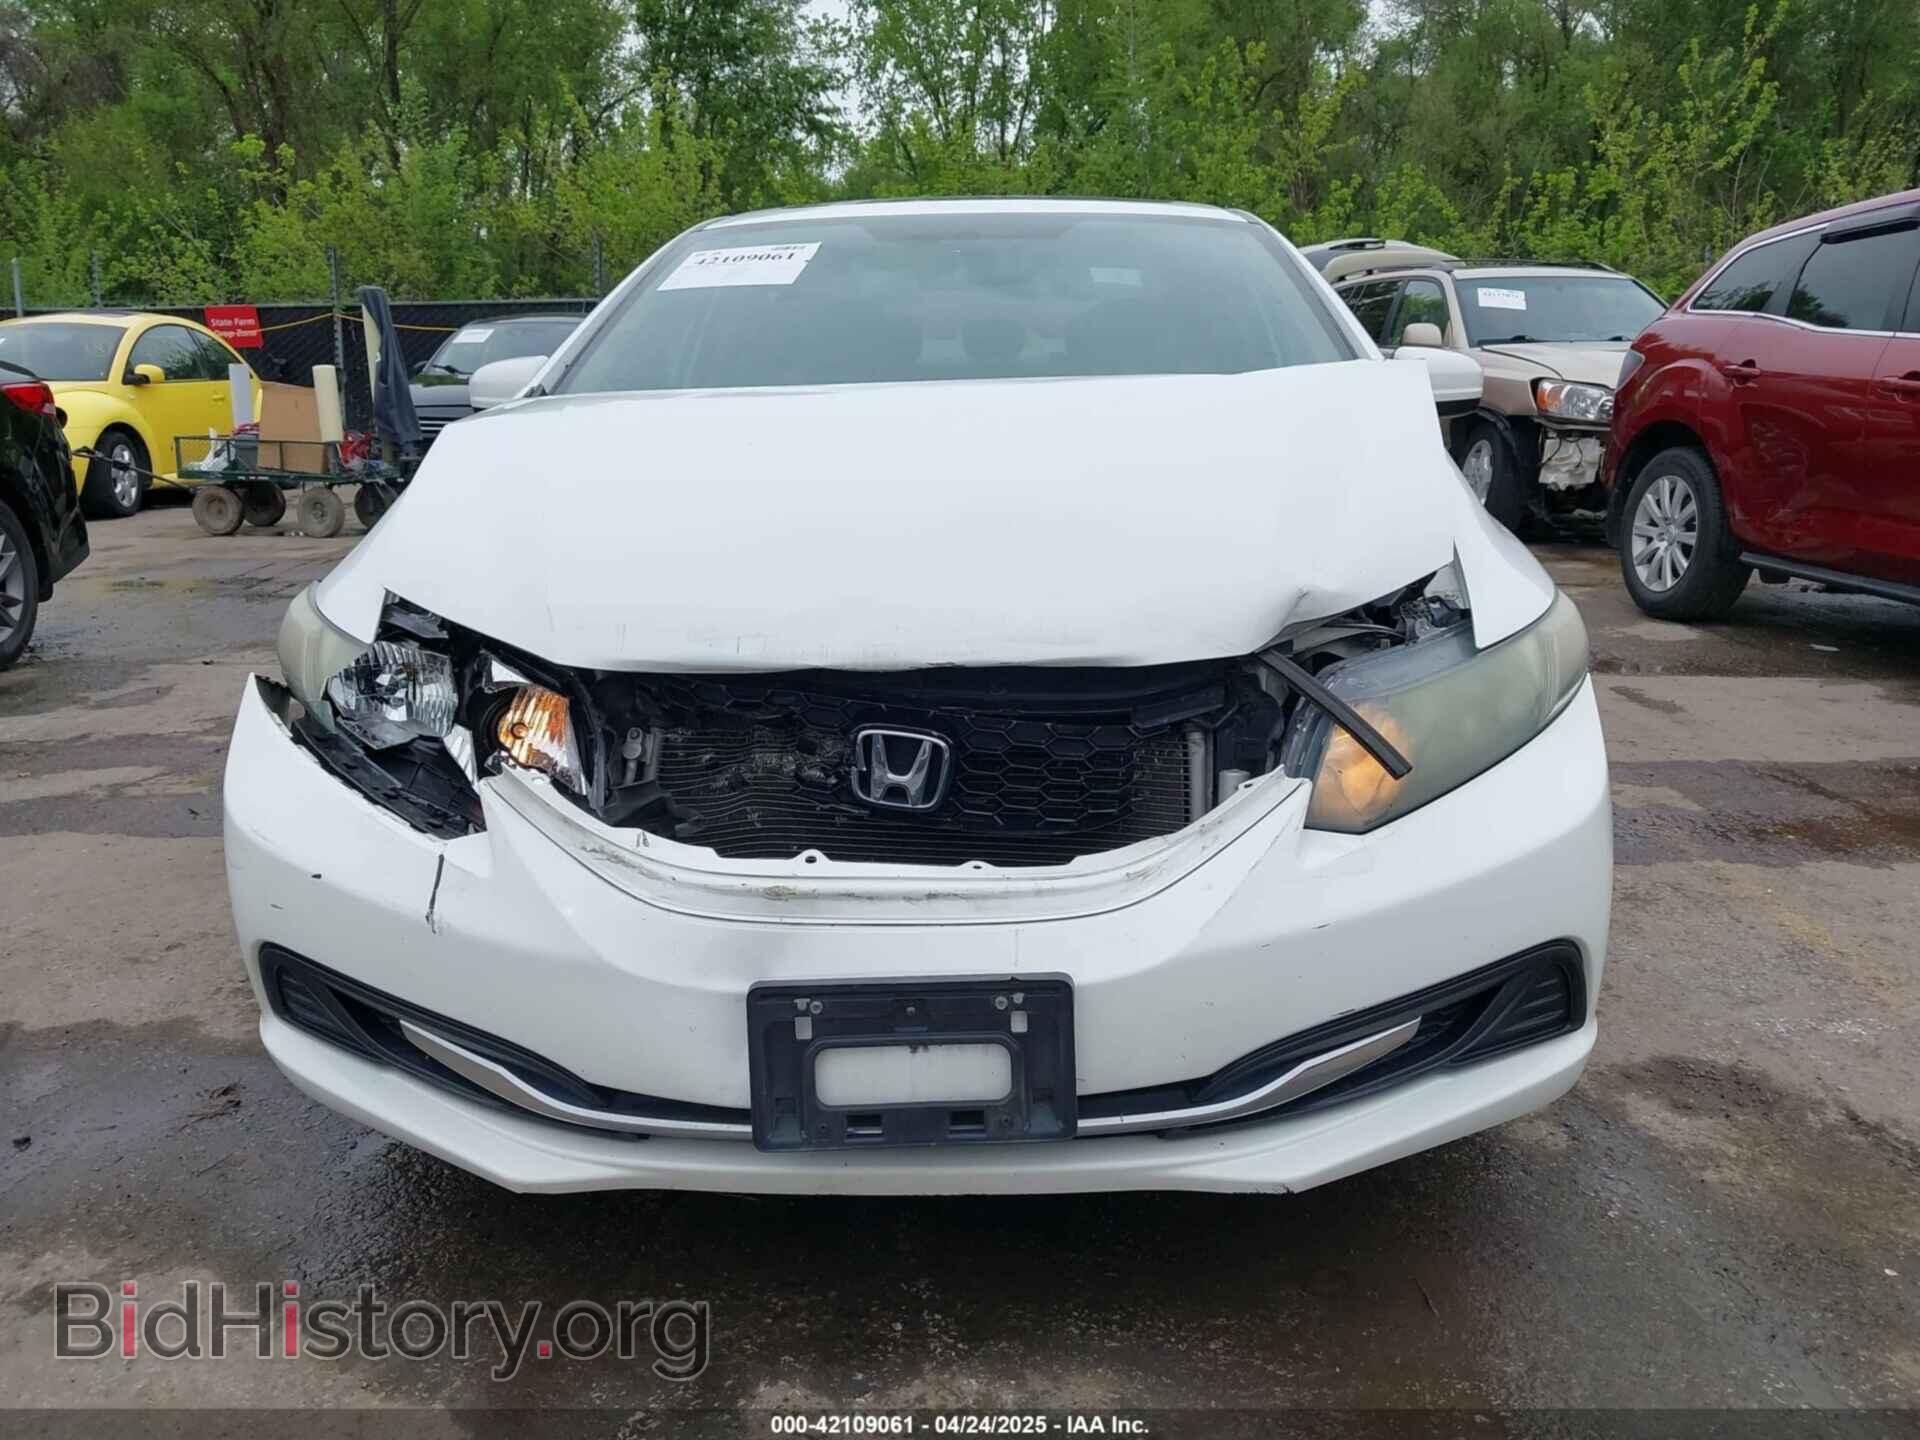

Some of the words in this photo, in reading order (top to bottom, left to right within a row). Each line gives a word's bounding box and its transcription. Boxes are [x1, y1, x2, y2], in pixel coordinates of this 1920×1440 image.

[693, 252, 796, 265] 42109061
[210, 318, 233, 327] State
[233, 318, 256, 326] Farm
